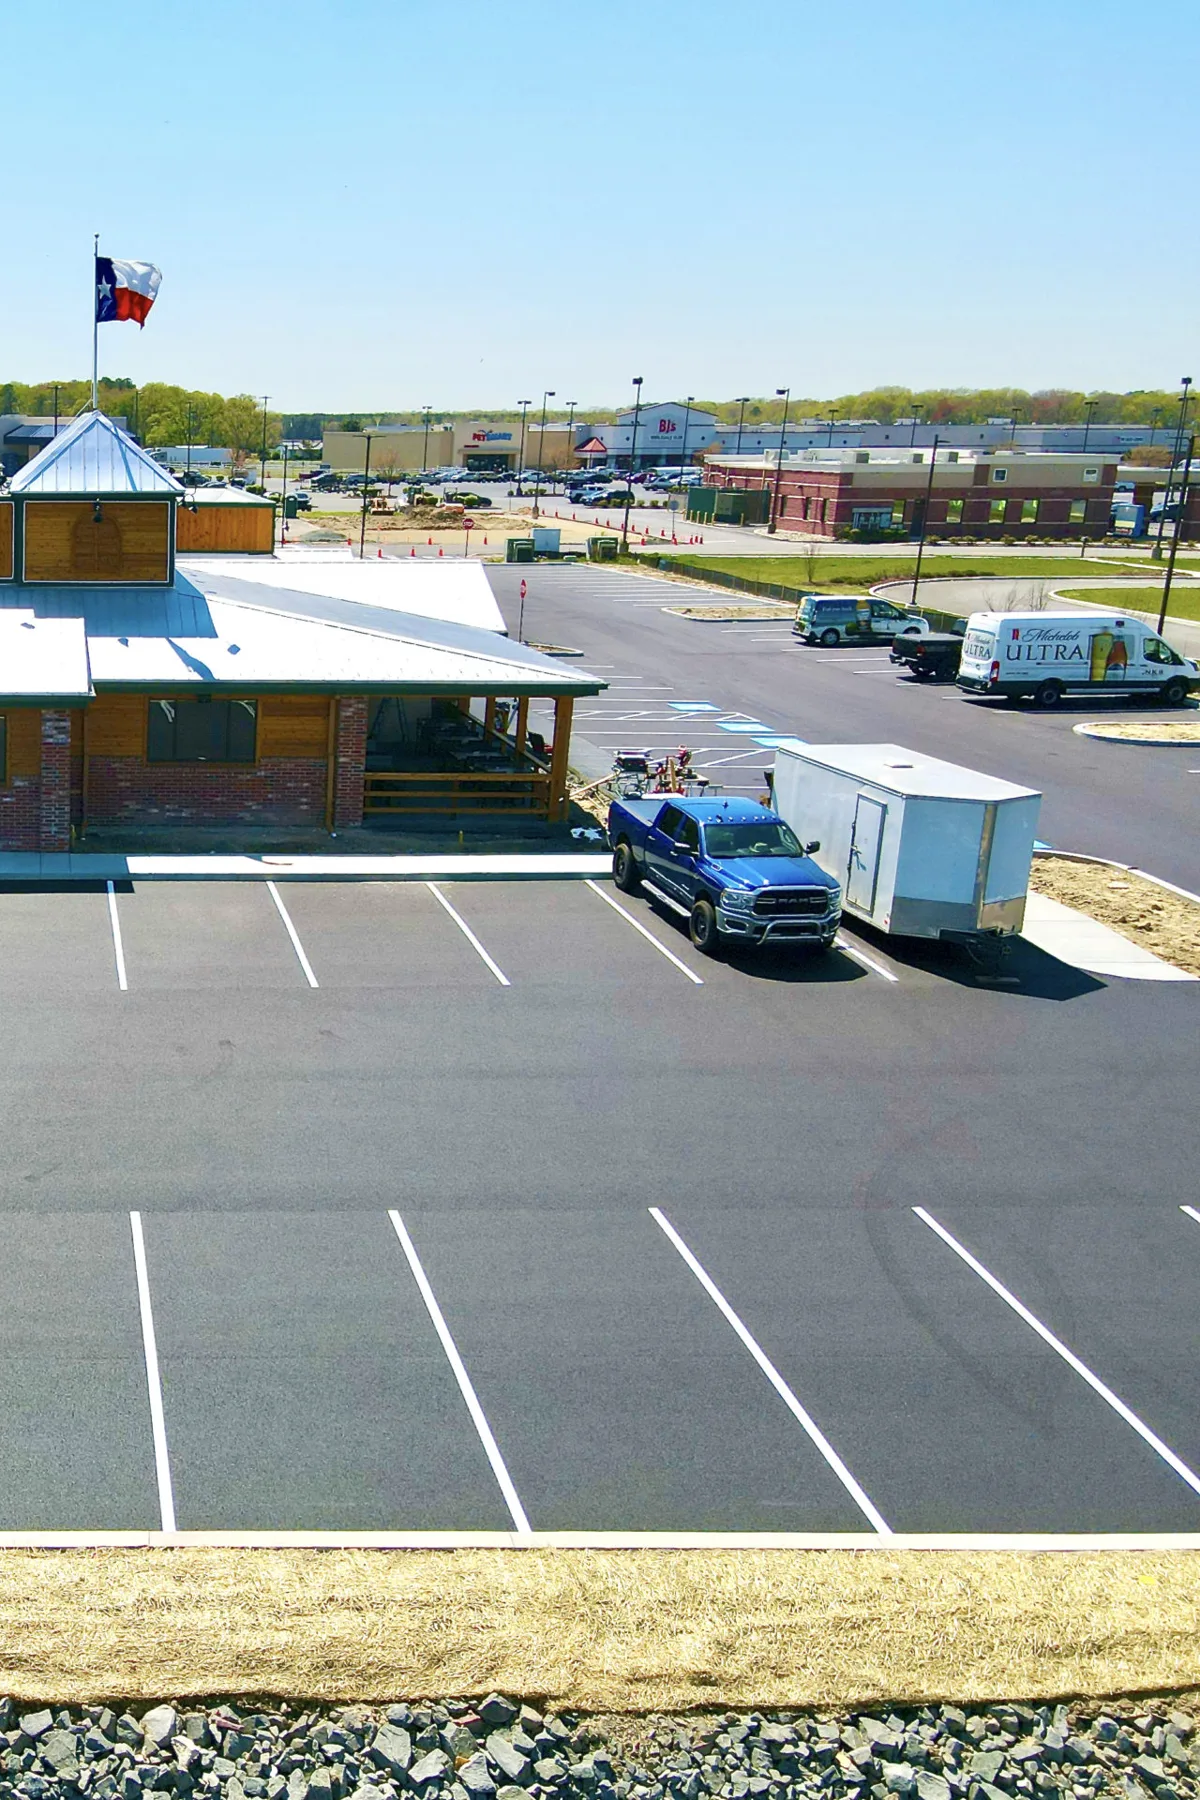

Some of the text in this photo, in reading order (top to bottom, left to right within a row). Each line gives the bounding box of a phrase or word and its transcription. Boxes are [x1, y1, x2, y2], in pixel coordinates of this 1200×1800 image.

[1022, 628, 1081, 642] Michelob
[964, 643, 991, 660] ULTRA
[1006, 643, 1085, 661] ULTRA
